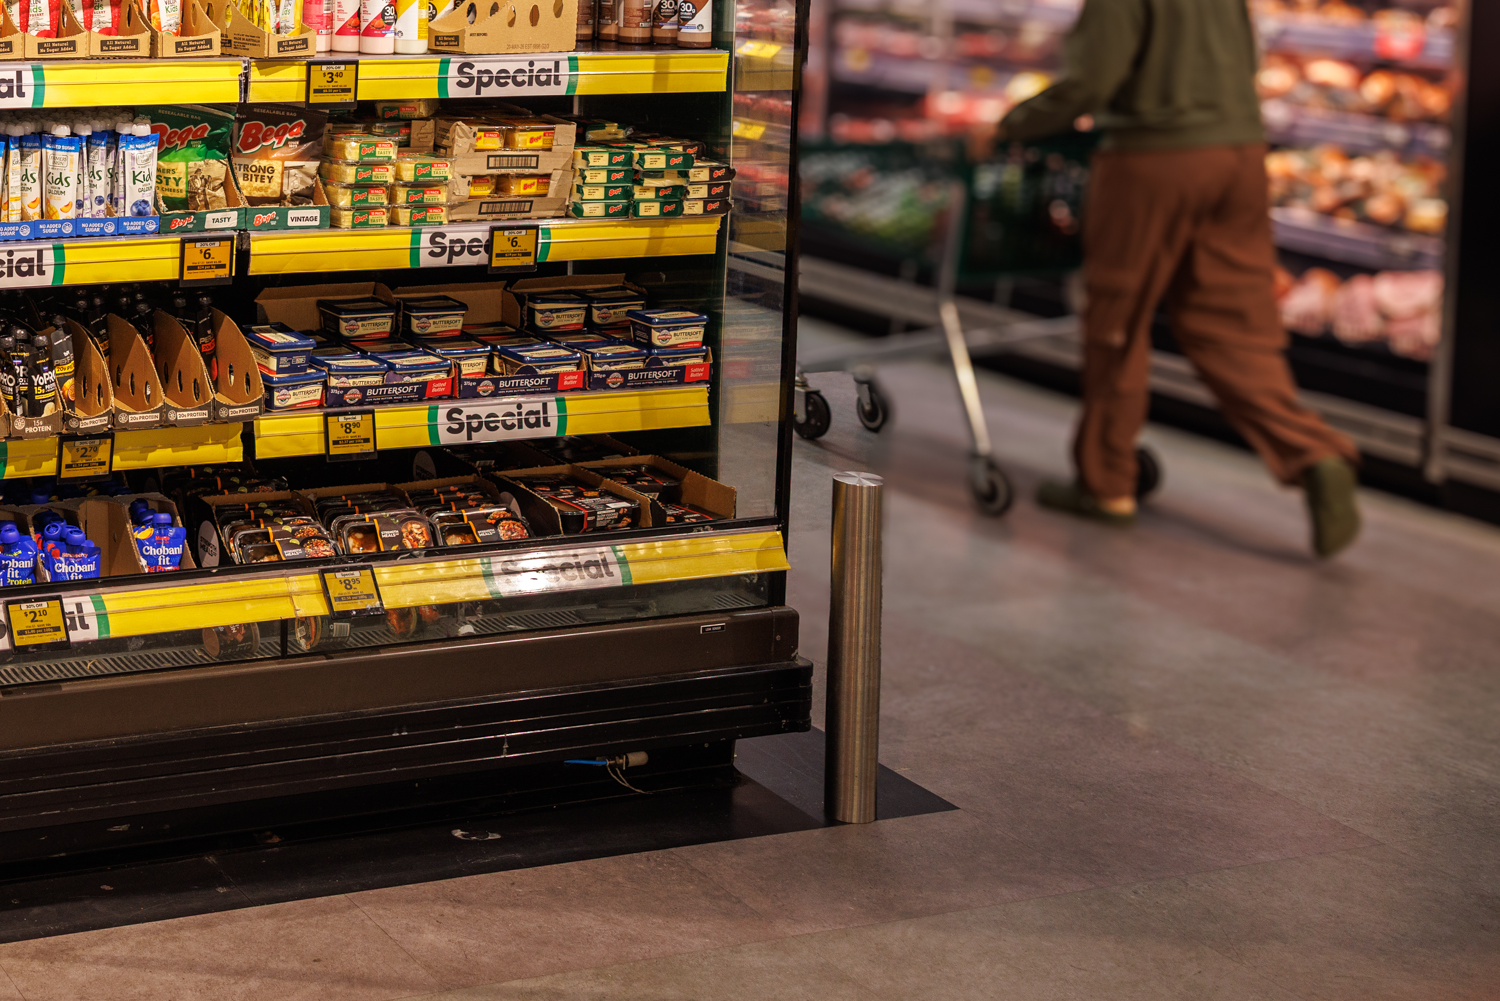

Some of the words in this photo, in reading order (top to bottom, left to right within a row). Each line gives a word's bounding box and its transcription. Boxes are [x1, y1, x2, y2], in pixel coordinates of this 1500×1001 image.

[165, 6, 178, 14] Kids
[456, 60, 562, 96] Special
[150, 122, 210, 148] Bega
[236, 119, 306, 154] Bega
[242, 174, 274, 183] BITEY
[170, 215, 194, 229] Bega
[211, 216, 232, 224] TASTY
[254, 212, 276, 226] Bega
[361, 321, 390, 329] BUTTERSOFT
[628, 370, 678, 380] BUTTERSOFT
[499, 378, 550, 388] BUTTERSOFT
[292, 389, 320, 397] BUTTERSOFT
[367, 385, 418, 396] BUTTERSOFT
[446, 401, 551, 441] Special
[142, 545, 182, 555] Chobani
[158, 554, 171, 565] fit
[54, 562, 95, 573] Chobani
